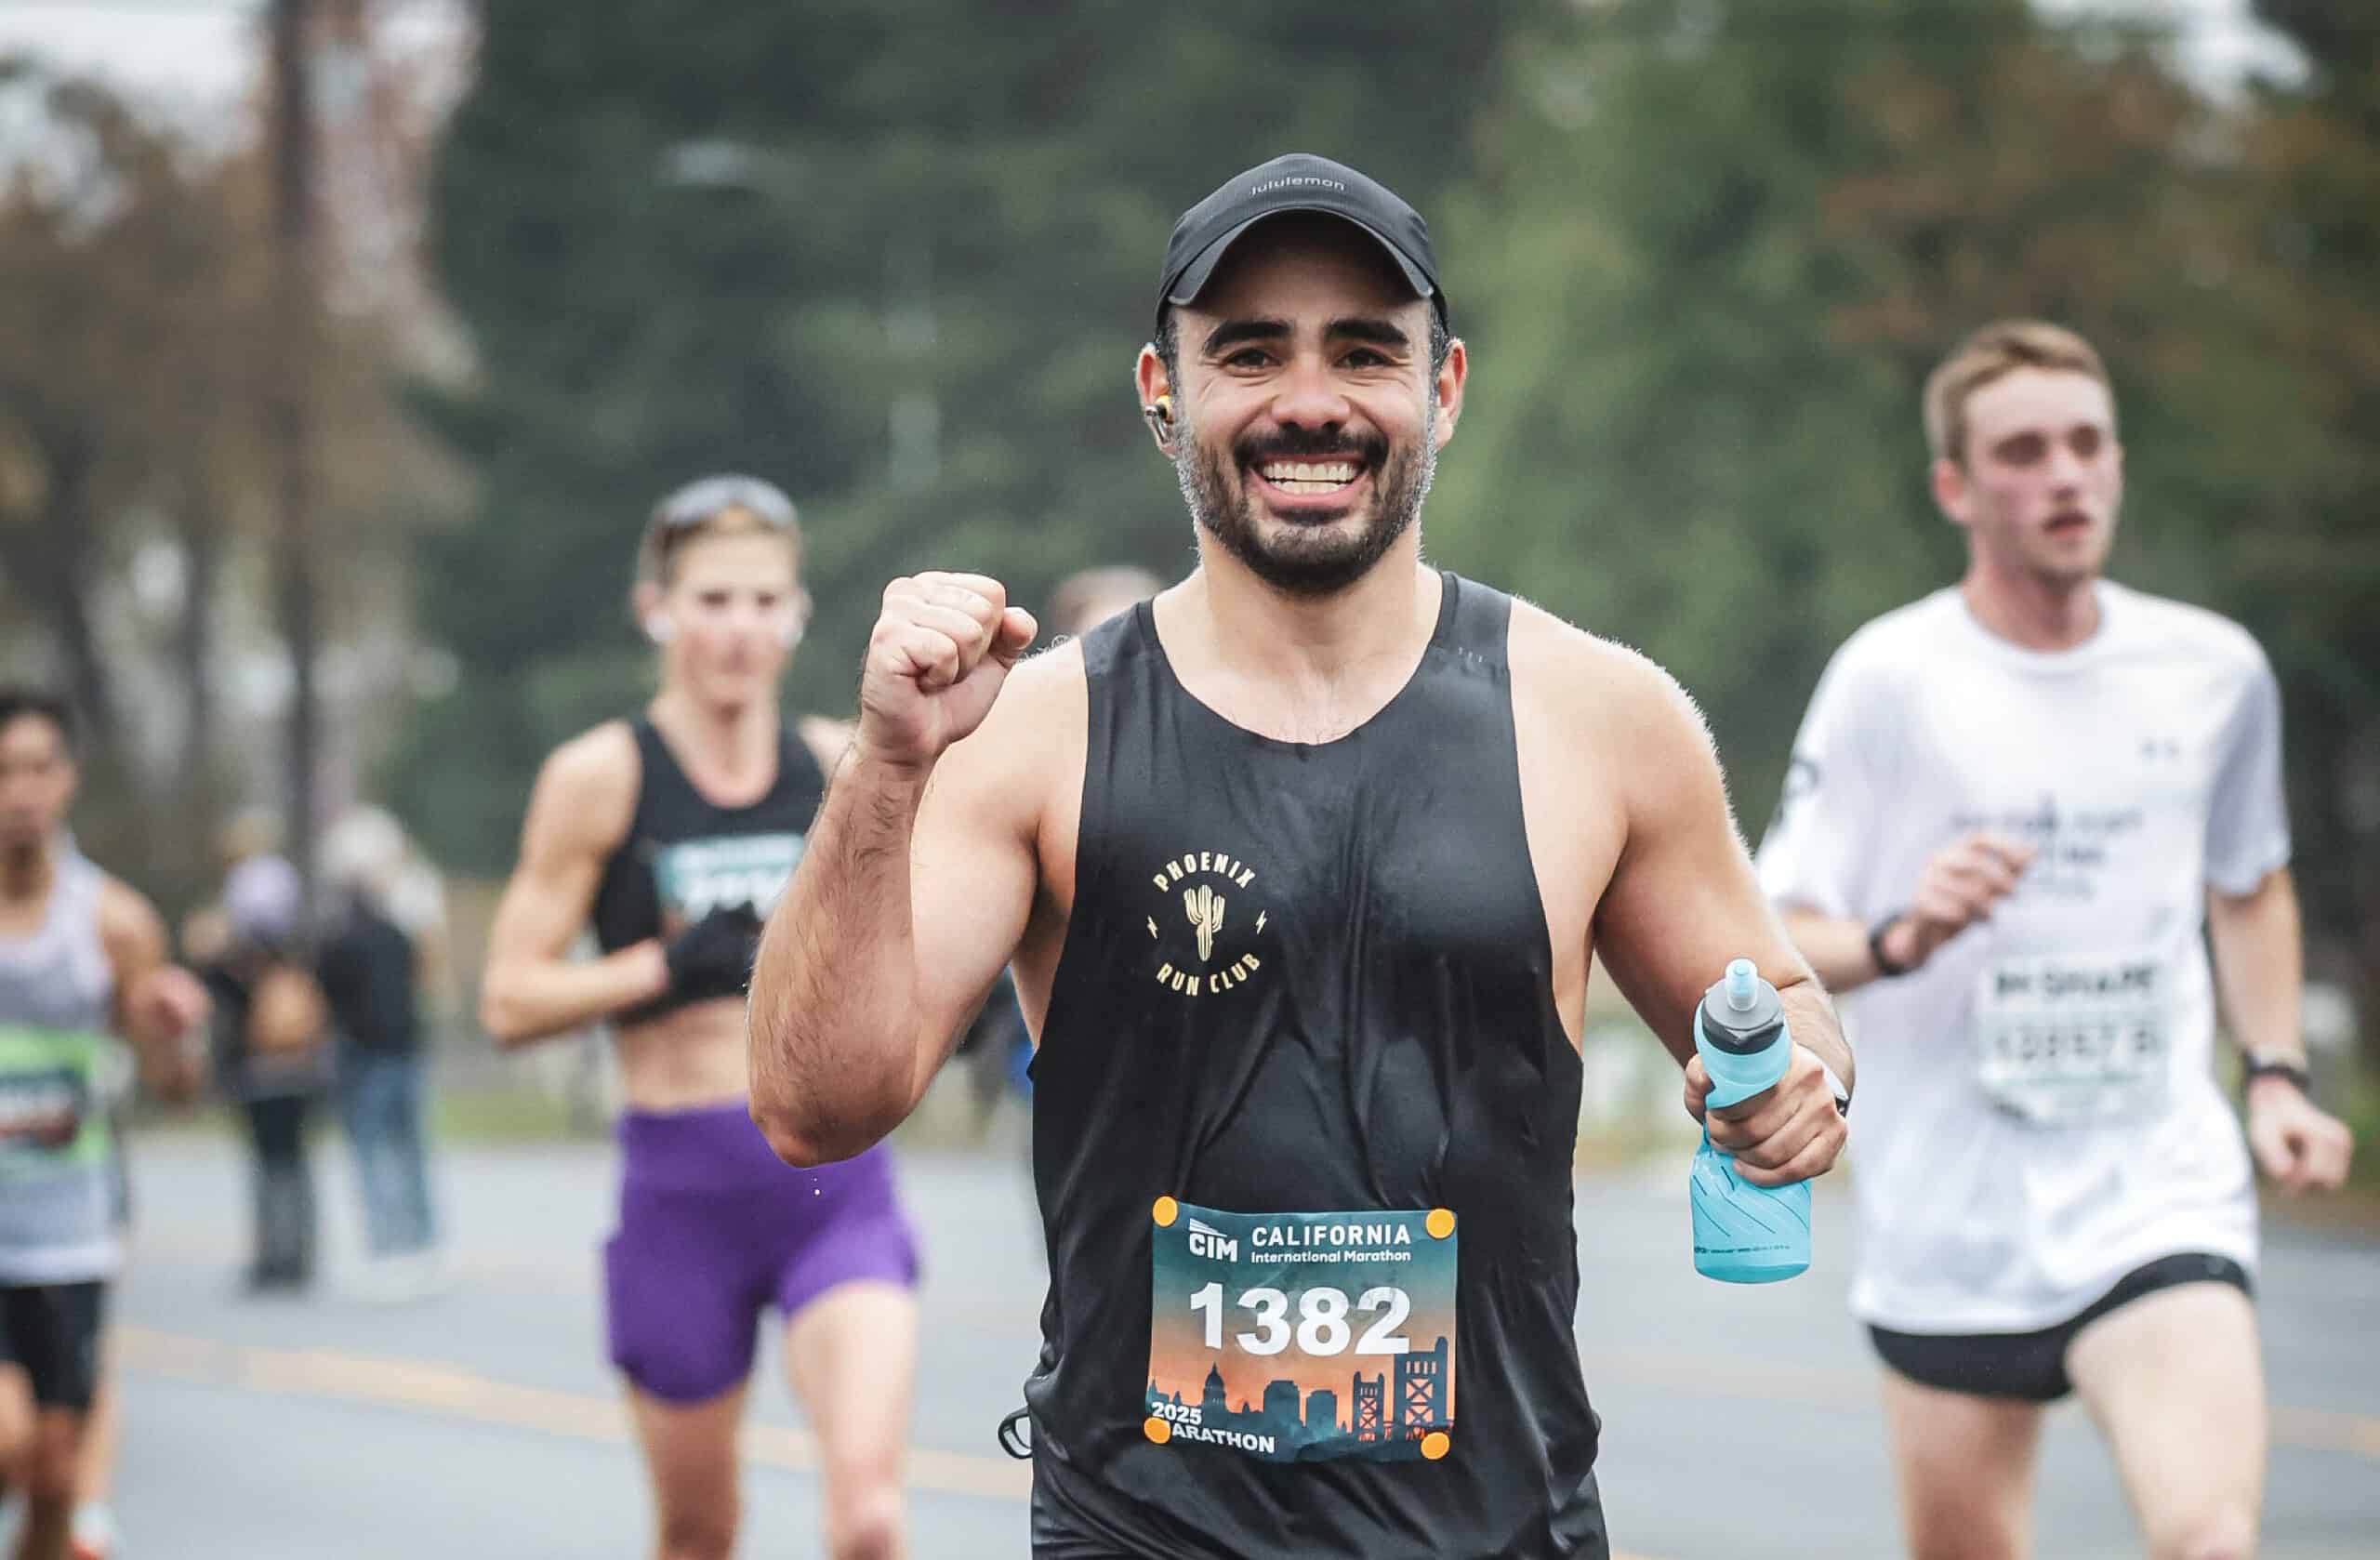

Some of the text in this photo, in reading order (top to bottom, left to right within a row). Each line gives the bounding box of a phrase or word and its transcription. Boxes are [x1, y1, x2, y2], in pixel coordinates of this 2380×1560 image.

[1250, 177, 1345, 195] lululemon
[1153, 852, 1255, 892] PHOENIX
[1156, 953, 1261, 996] RUN CLUB
[1189, 1232, 1237, 1262] CIM
[1251, 1223, 1411, 1247] CALIFORNIA
[1251, 1249, 1411, 1263] International Marathon
[1189, 1281, 1411, 1356] 1382
[1151, 1401, 1202, 1425] 2025
[1171, 1422, 1276, 1453] ARATHON
